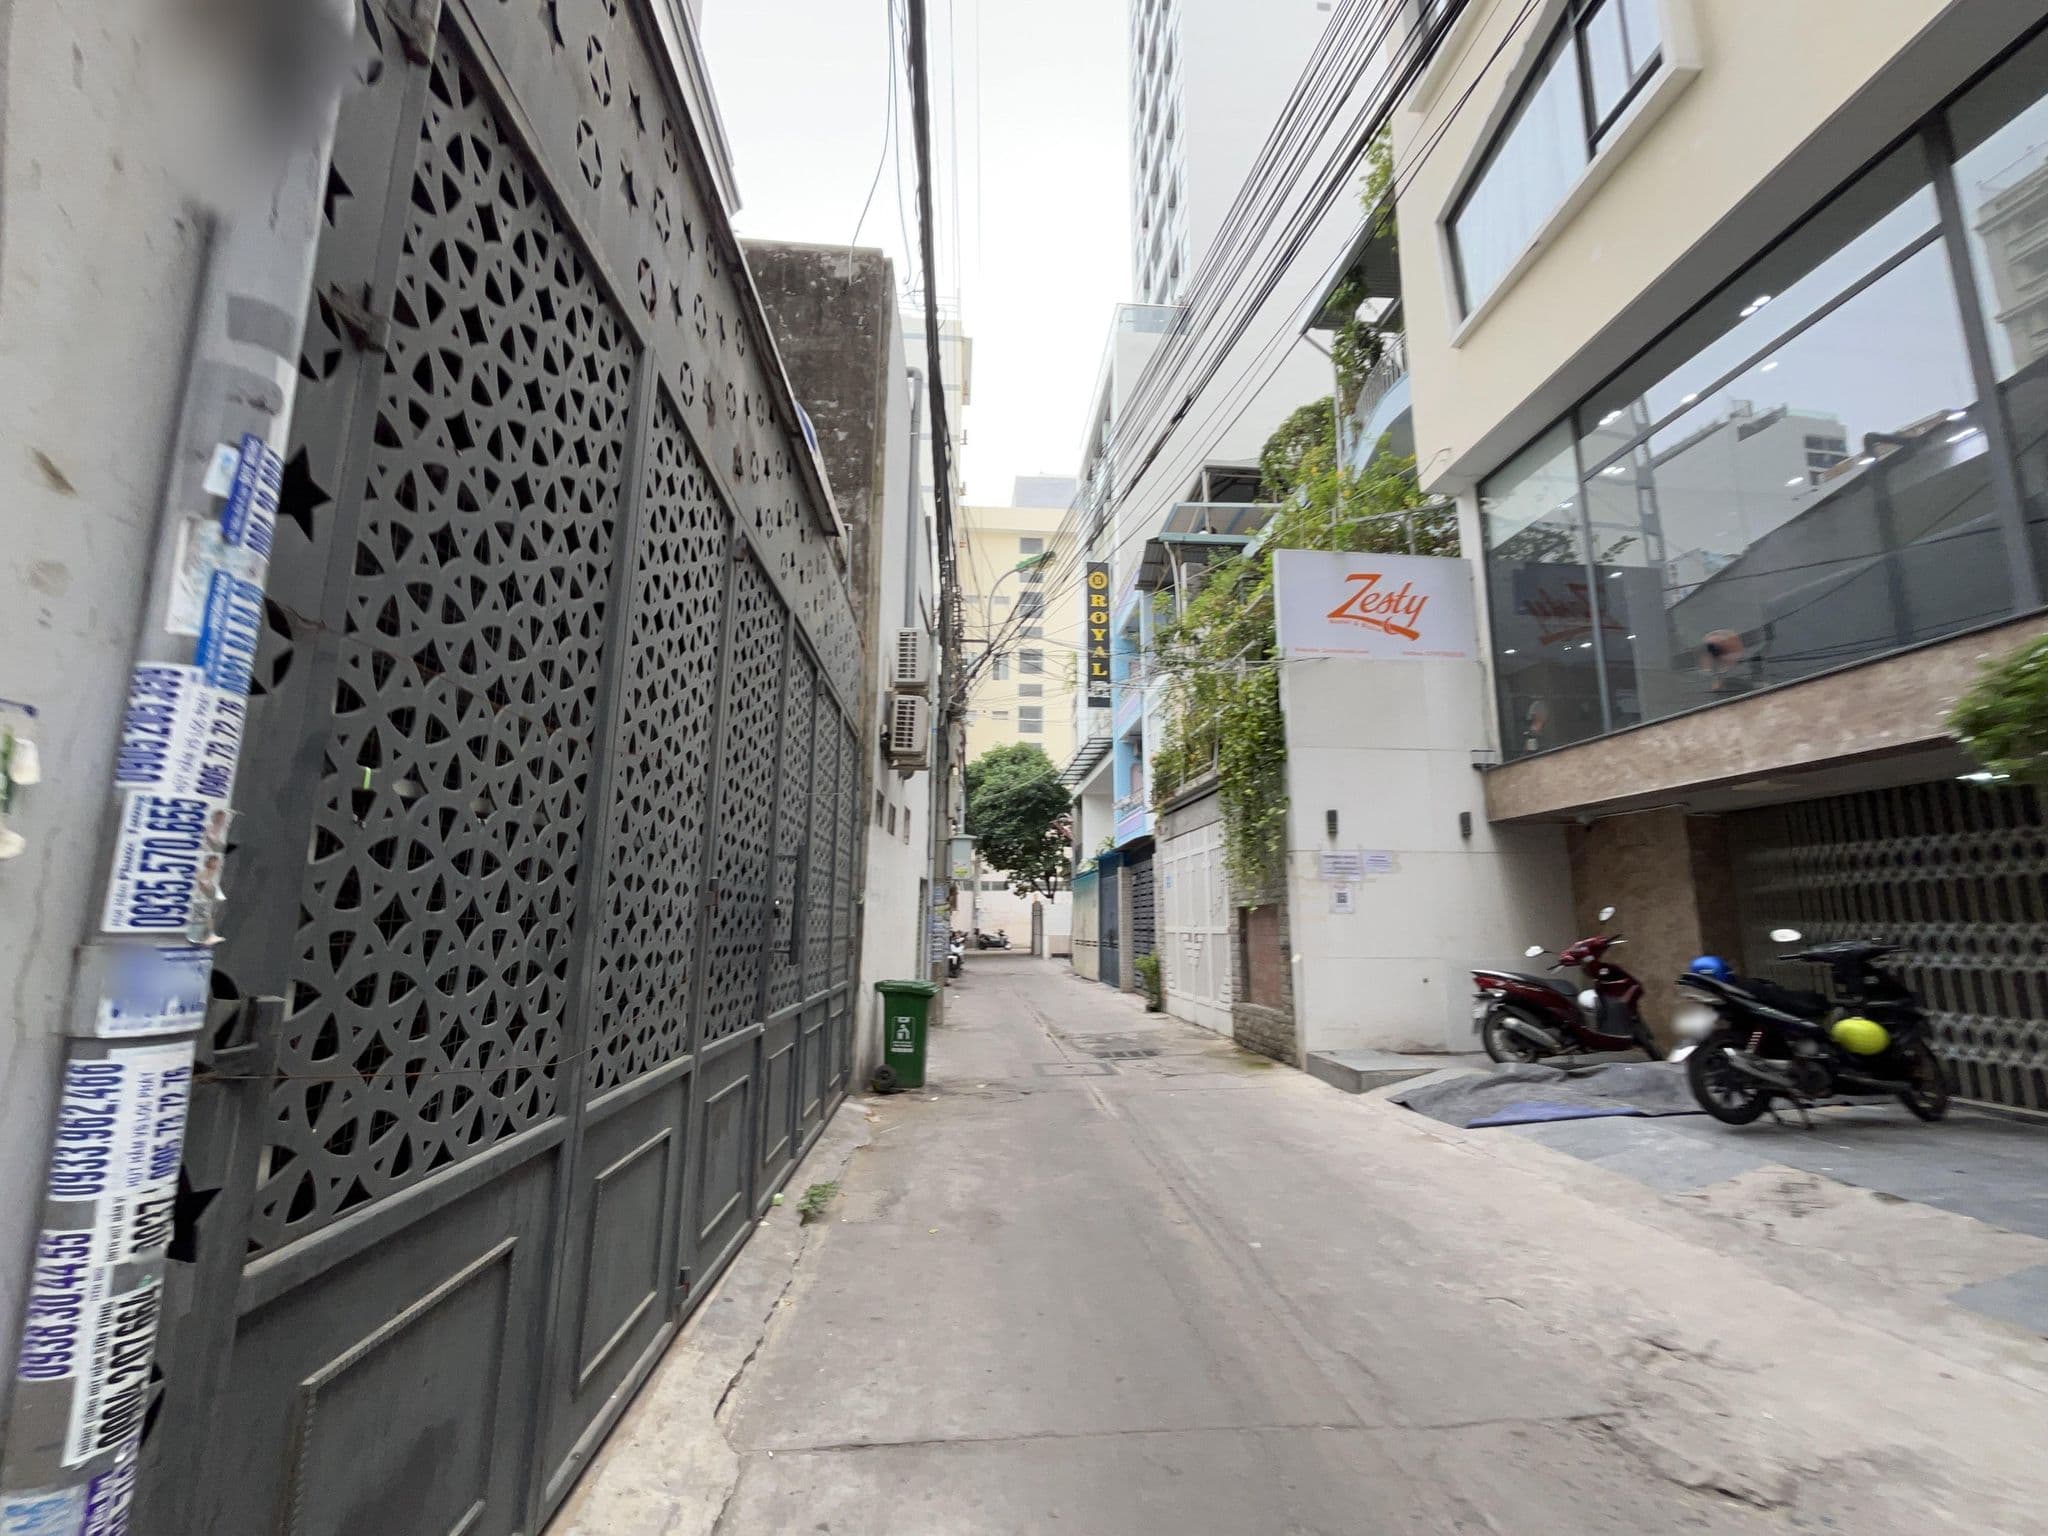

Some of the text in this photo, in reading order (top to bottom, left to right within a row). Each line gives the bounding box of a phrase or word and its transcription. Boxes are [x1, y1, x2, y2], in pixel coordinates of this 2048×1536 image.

[1089, 594, 1108, 676] ROYAL
[1327, 573, 1430, 641] Zesty
[128, 797, 207, 927] 0935.570.655
[48, 1064, 123, 1196] 0933.962.466
[17, 1233, 92, 1379] 0938.30.44.55
